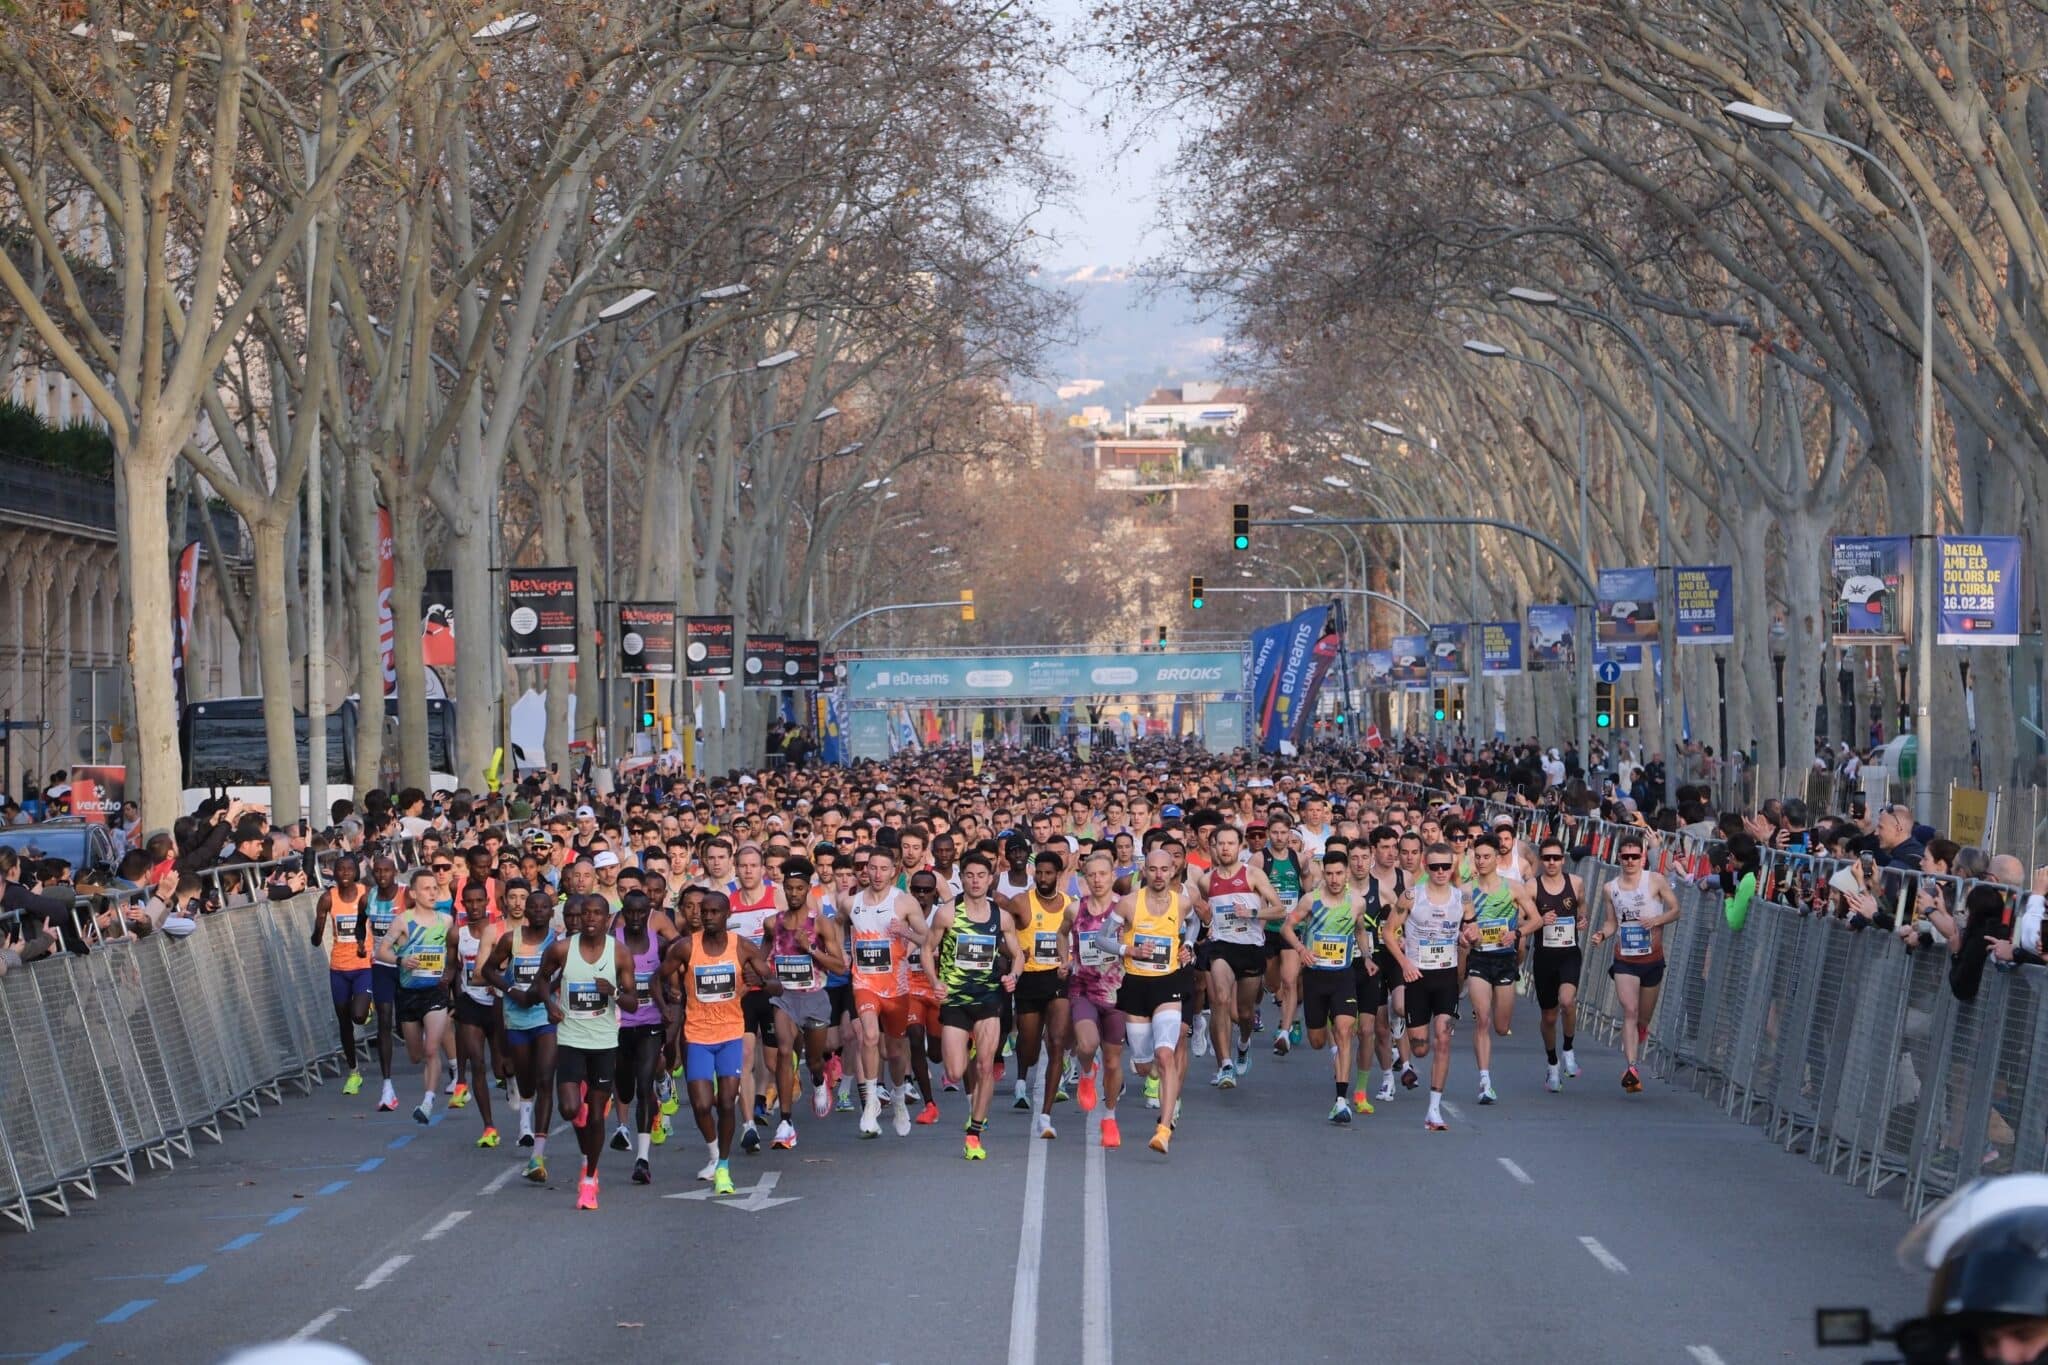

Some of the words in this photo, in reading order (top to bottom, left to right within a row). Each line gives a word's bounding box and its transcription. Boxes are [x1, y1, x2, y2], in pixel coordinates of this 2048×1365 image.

[1944, 544, 1983, 556] BATEGA
[1944, 557, 1966, 569] AMB
[1969, 558, 1987, 569] ELS
[1944, 570, 1984, 582] COLORS
[1987, 571, 2000, 582] DE
[509, 579, 574, 595] BCNegra
[1944, 583, 1956, 595] LA
[1959, 583, 1994, 595] CURSA
[1944, 597, 1994, 609] 16.02.25
[622, 610, 673, 624] BCNegra
[1280, 623, 1312, 694] eDreams
[892, 671, 949, 685] eDreams
[1157, 667, 1223, 681] BROOKS
[968, 945, 983, 953] PHIL
[701, 974, 732, 985] KIPLIMO
